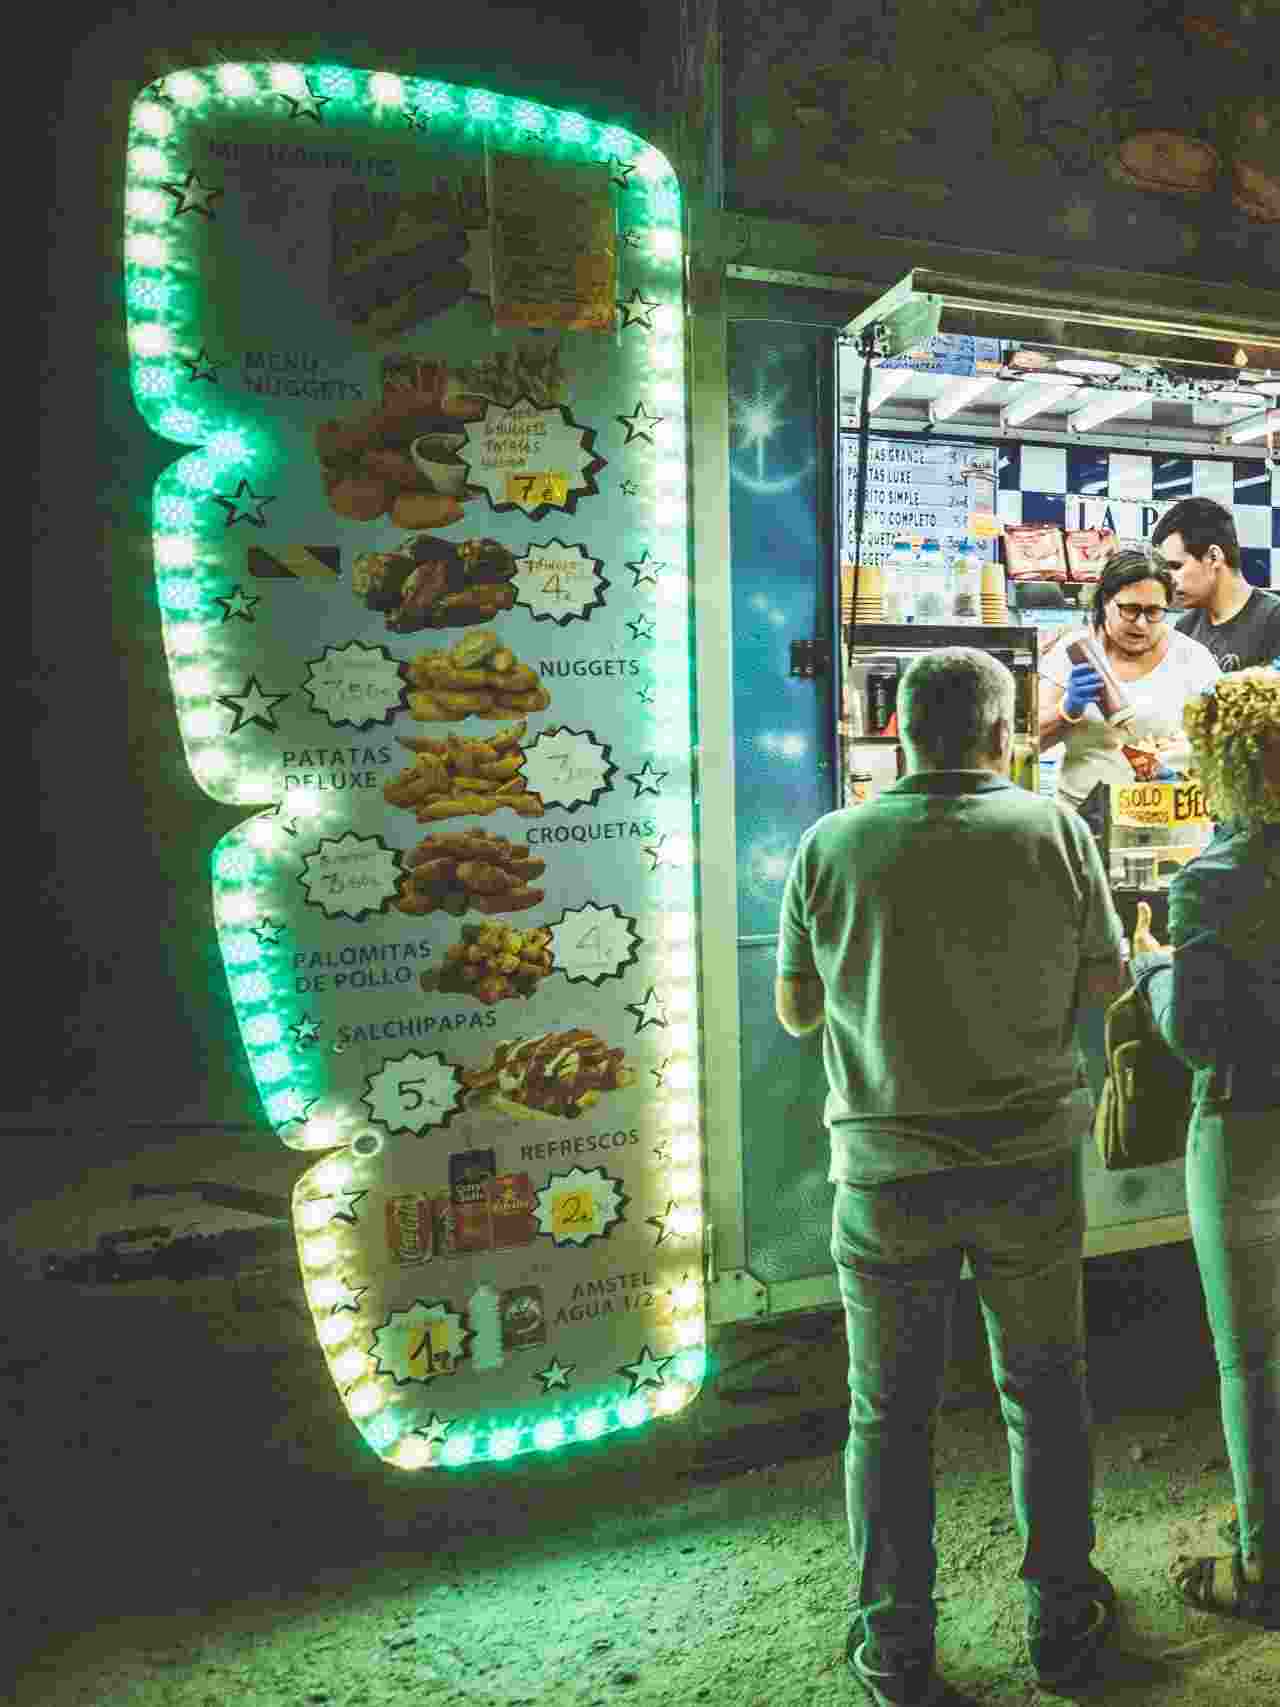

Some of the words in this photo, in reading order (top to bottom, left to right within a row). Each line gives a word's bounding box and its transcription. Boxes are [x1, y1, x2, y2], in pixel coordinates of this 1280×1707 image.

[245, 375, 364, 401] NUGGETS
[888, 471, 912, 484] LUXE
[888, 489, 920, 506] SIMPLE
[887, 510, 937, 528] COMPLETO
[539, 659, 641, 677] NUGGETS
[282, 745, 393, 768] PATATAS
[283, 770, 377, 791] DELUXE
[526, 820, 655, 844] CROQUETAS
[293, 938, 432, 969] PALOMITAS
[294, 975, 329, 993] DE
[335, 966, 413, 989] POLLO
[337, 1009, 498, 1041] SALCHIPAPAS
[520, 1128, 641, 1161] REFRESCOS
[571, 1271, 654, 1302] AMSTEL
[553, 1297, 615, 1328] AGUA
